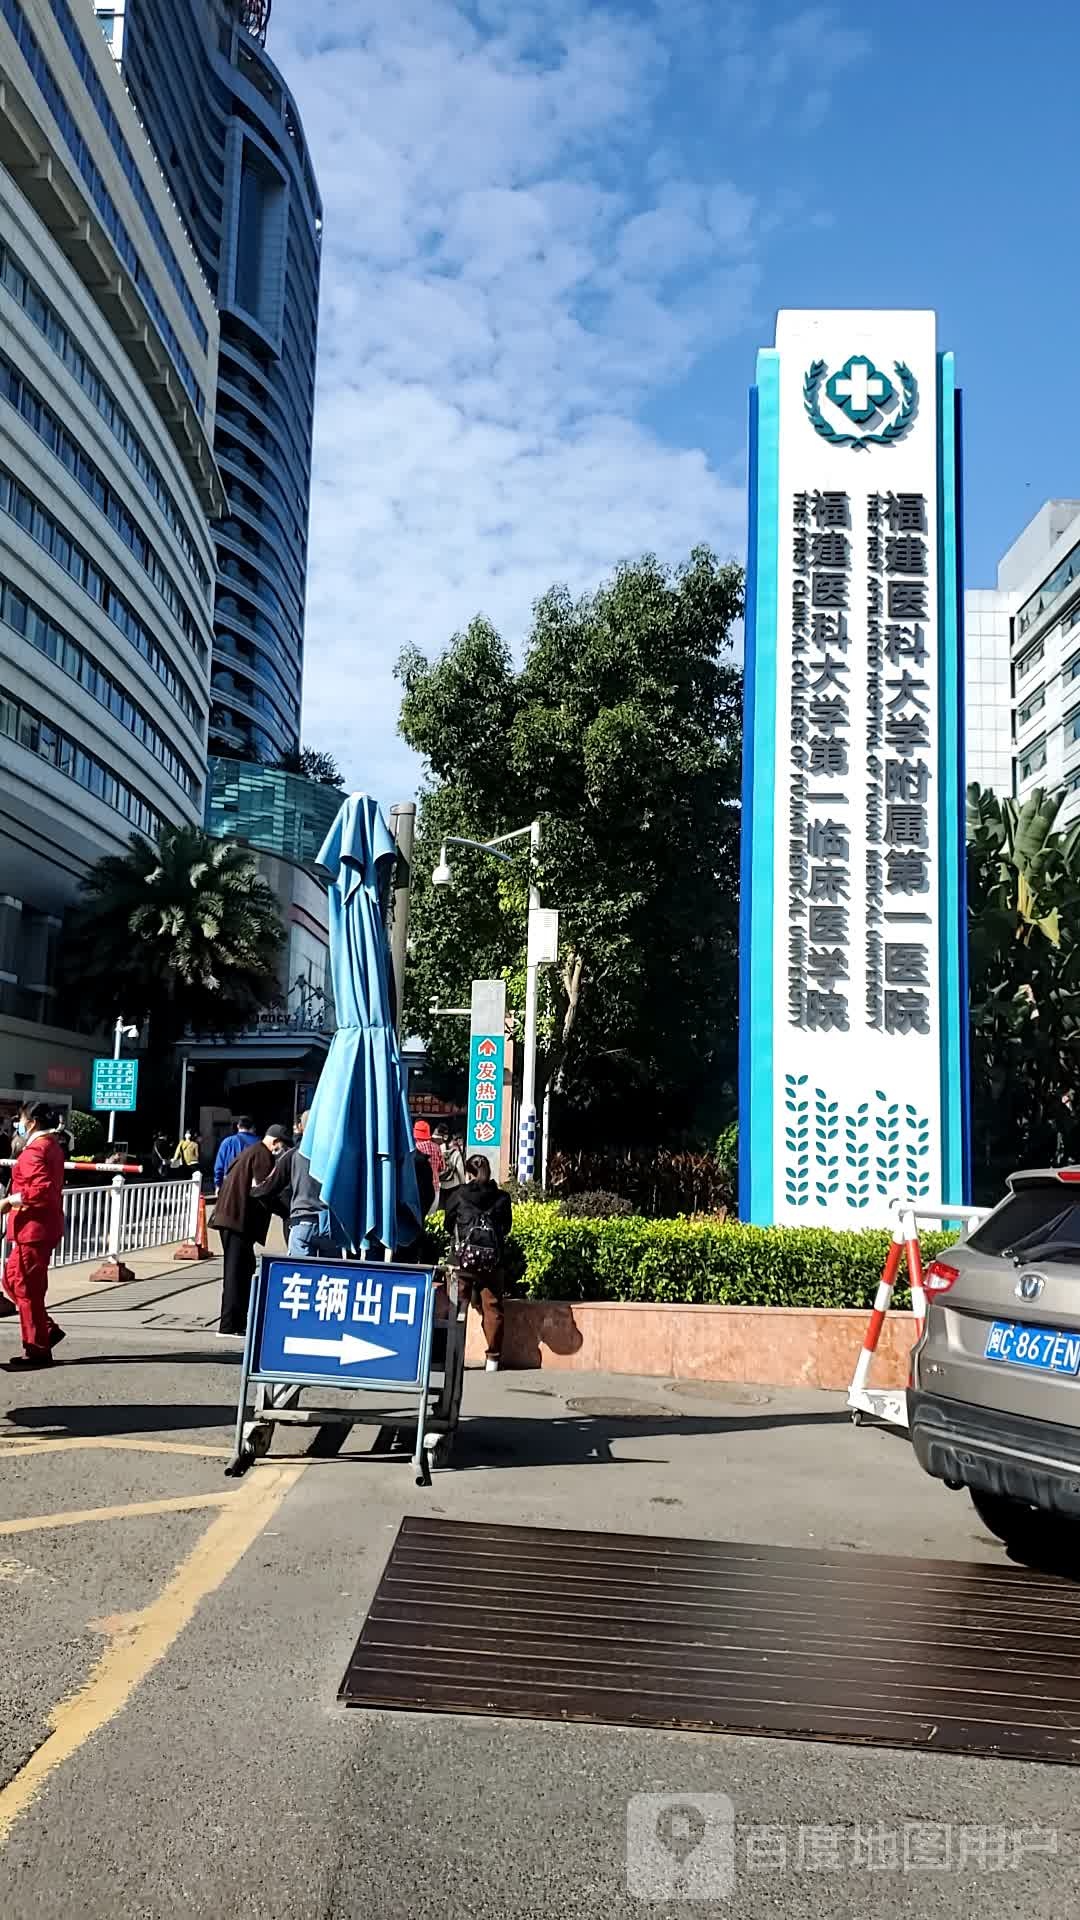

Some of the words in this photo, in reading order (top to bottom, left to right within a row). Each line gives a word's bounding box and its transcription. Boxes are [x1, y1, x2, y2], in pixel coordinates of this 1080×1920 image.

[792, 491, 809, 526] THE
[867, 492, 883, 525] THE
[792, 527, 809, 576] FIRST
[867, 525, 883, 576] FIRST
[792, 579, 809, 658] CLINICAL
[867, 577, 883, 669] AFFILIATED
[791, 659, 808, 744] COLLEGE
[866, 672, 883, 752] HOSPITAL
[790, 745, 807, 772] OF
[808, 489, 851, 1032] 福建医科大学第一临床医学院
[866, 755, 883, 781] OF
[885, 491, 932, 1034] 福建医科大学附属第一医院
[789, 774, 808, 837] FUJIAN
[866, 783, 883, 844] FUJIAN
[789, 839, 807, 922] MEDICAL
[866, 849, 883, 927] MEDICAL
[788, 926, 807, 1032] UNIVERSITY
[866, 930, 883, 1033] UNIVERSITY
[475, 1062, 496, 1141] 发热门诊
[279, 1272, 417, 1325] 车辆出口
